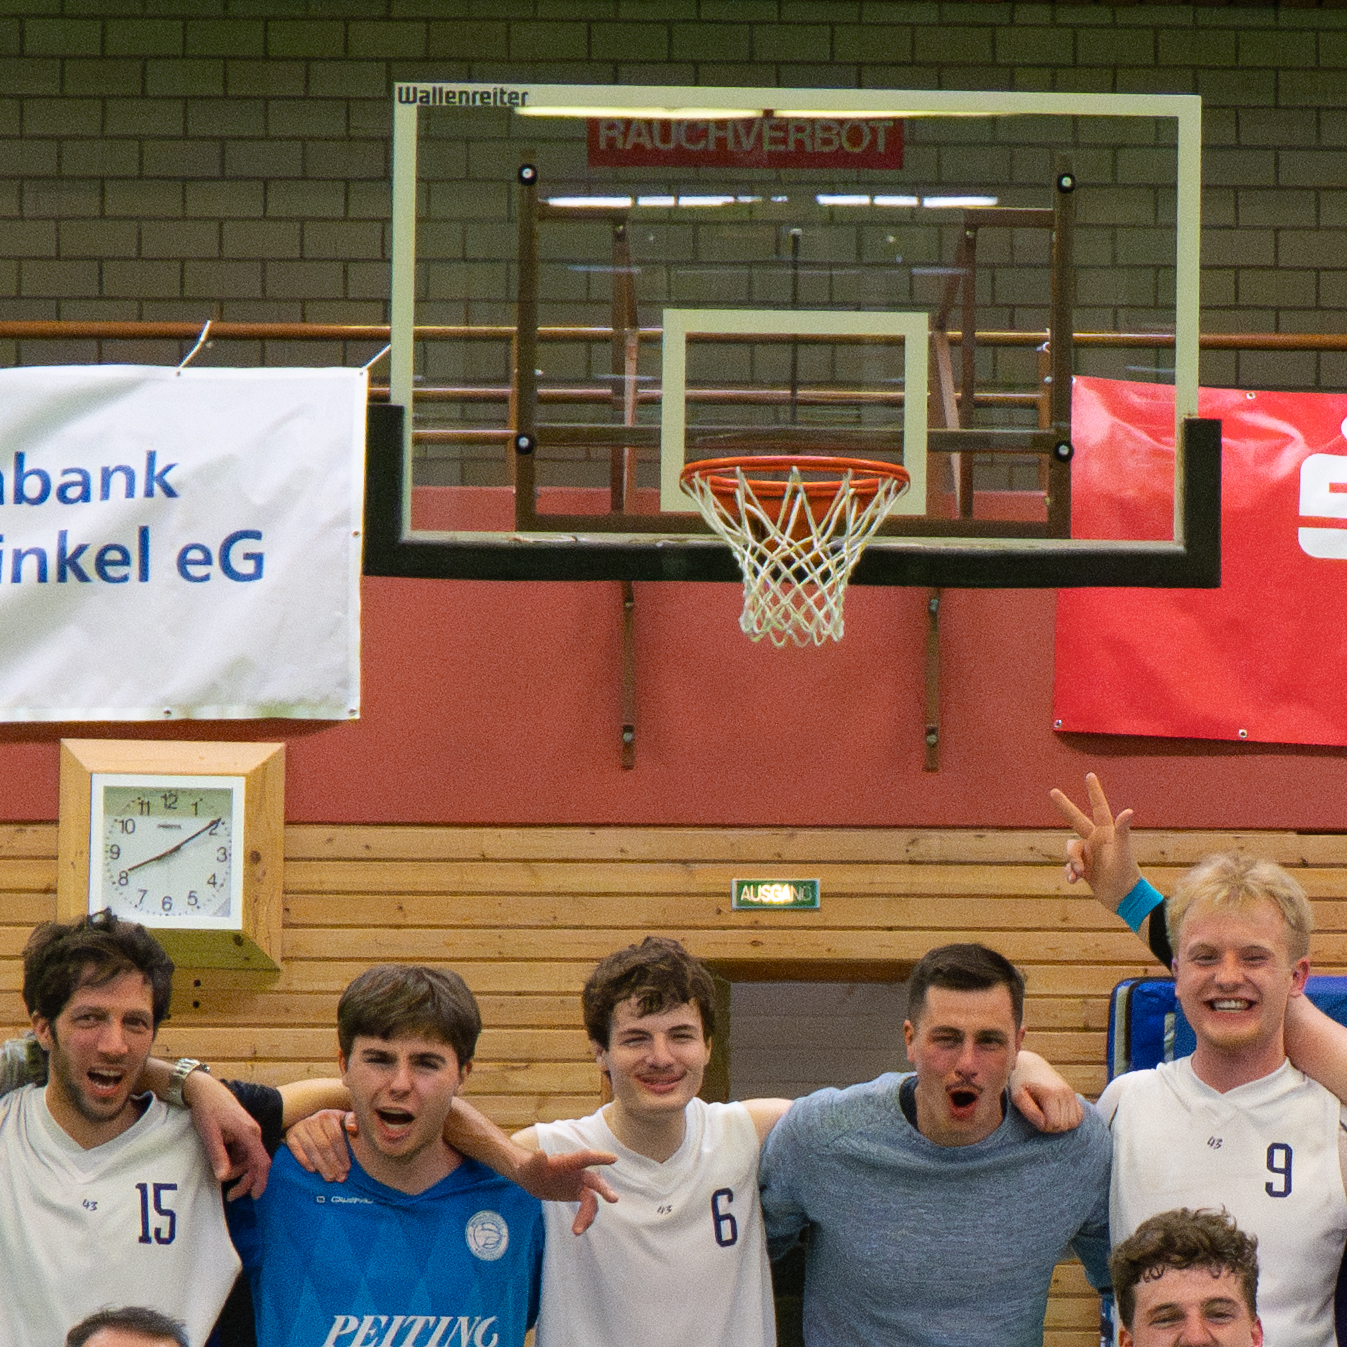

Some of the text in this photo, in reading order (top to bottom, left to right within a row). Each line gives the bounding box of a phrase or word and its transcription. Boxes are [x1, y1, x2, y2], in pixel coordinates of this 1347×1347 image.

[397, 86, 529, 107] Wallenreiter
[598, 118, 895, 153] RAUCHVERBOT
[175, 530, 266, 584] eG
[119, 817, 136, 835] 10
[109, 844, 121, 860] 9
[216, 846, 228, 863] 3
[118, 870, 129, 887] 8
[207, 872, 218, 889] 4
[137, 889, 149, 906] 7
[161, 896, 173, 912] 6
[187, 890, 199, 907] 5
[1265, 1142, 1294, 1198] 9
[134, 1182, 179, 1246] 15
[710, 1187, 739, 1249] 6
